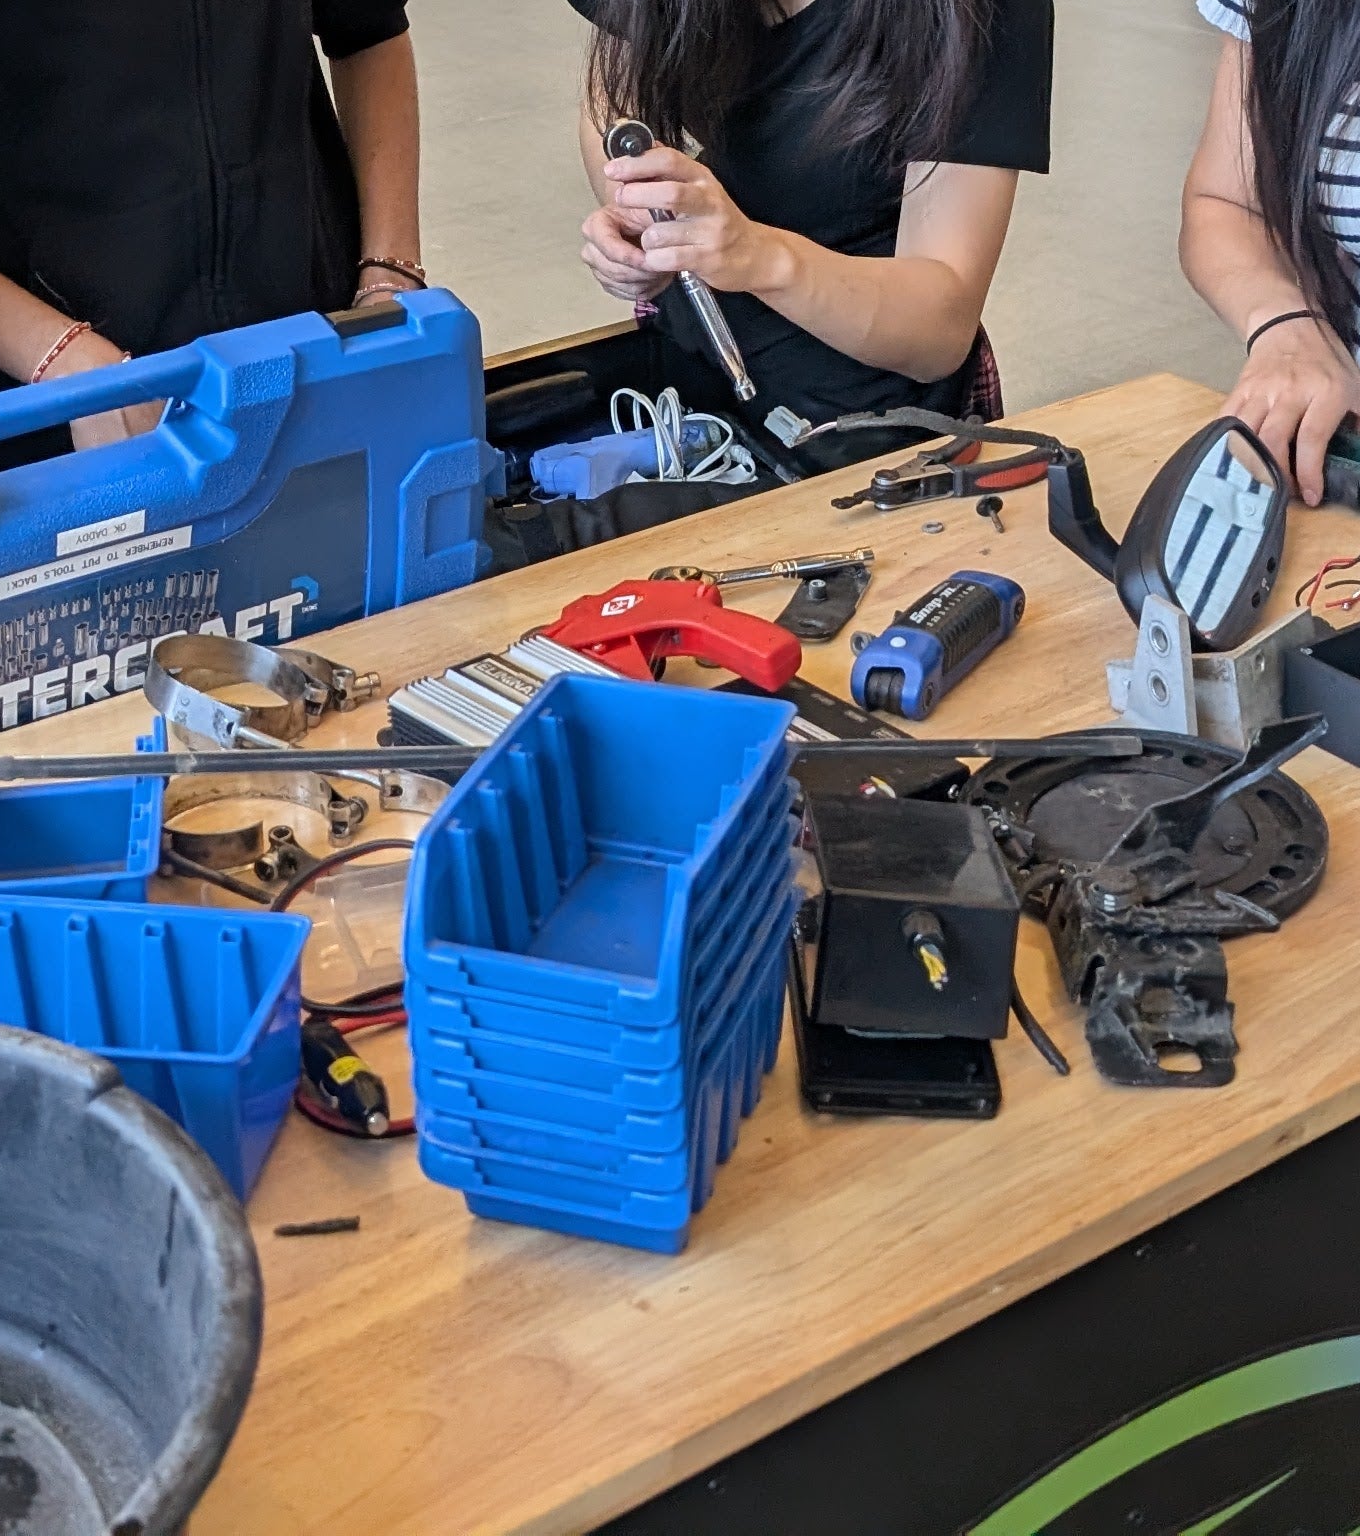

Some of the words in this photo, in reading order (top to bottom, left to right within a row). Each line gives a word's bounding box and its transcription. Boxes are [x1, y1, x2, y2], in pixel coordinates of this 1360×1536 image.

[75, 527, 109, 545] DADDY
[113, 522, 127, 533] OK
[125, 536, 175, 557] REMEMBER
[82, 555, 101, 569] PUT
[106, 551, 119, 562] TO
[43, 563, 75, 580] TOOLS
[6, 574, 38, 592] BACK!
